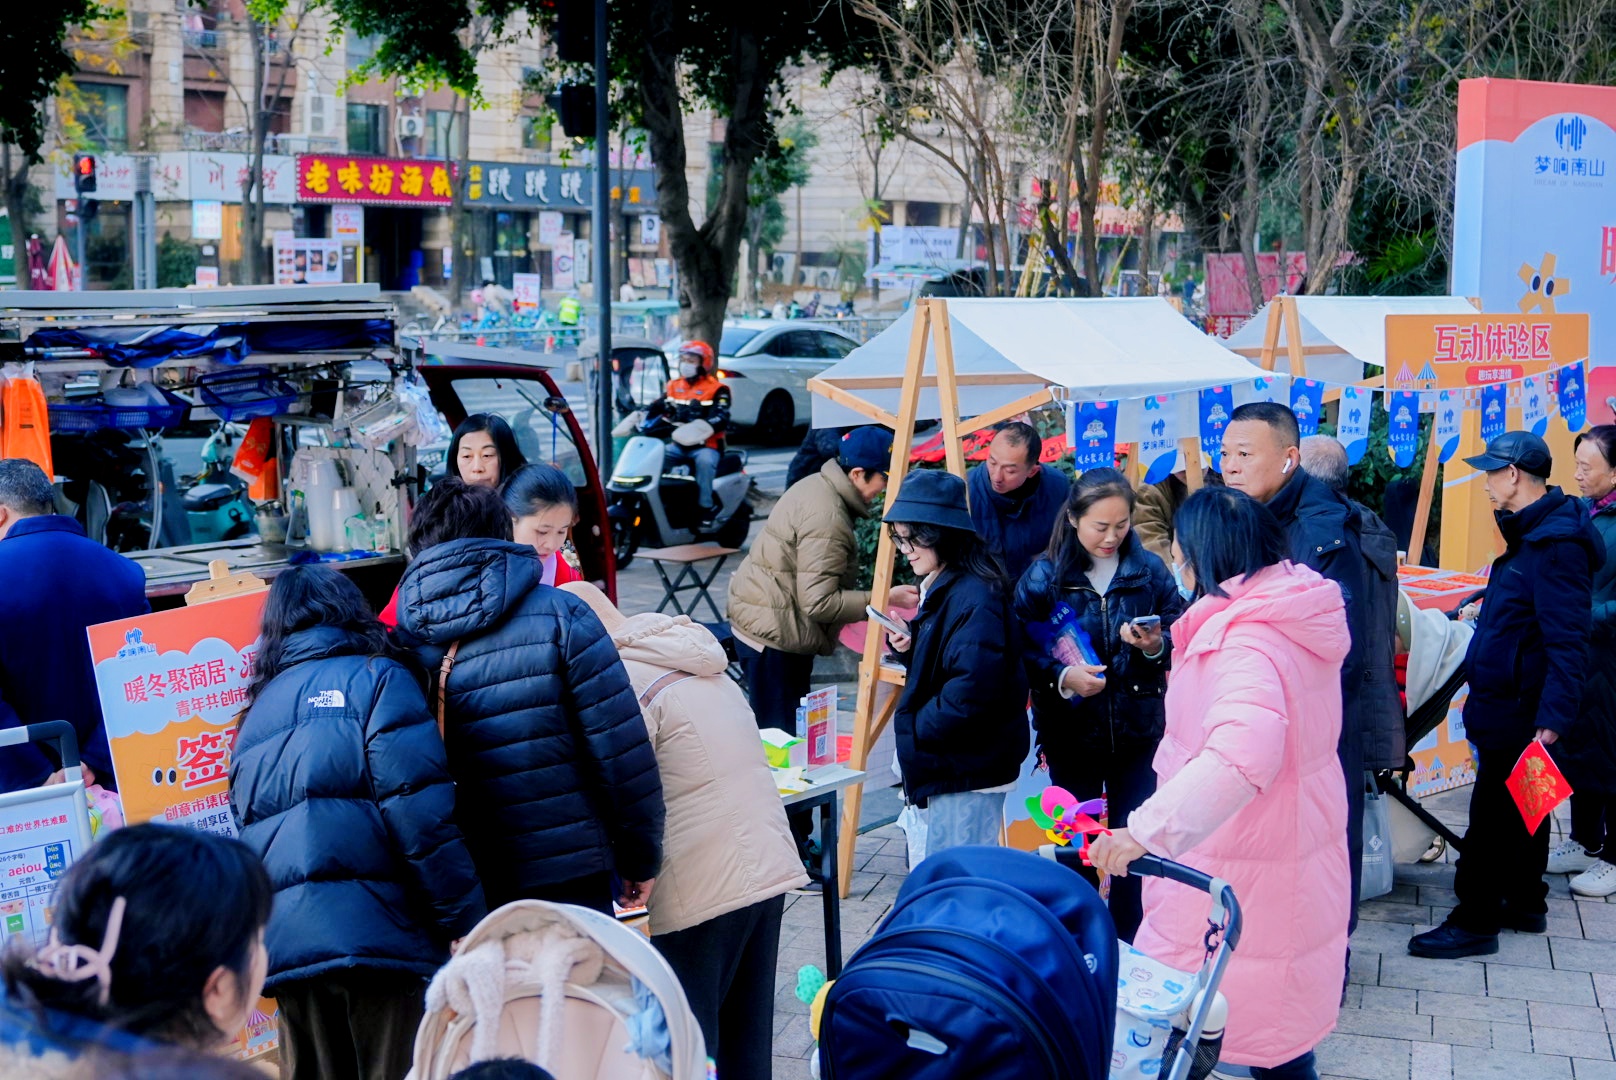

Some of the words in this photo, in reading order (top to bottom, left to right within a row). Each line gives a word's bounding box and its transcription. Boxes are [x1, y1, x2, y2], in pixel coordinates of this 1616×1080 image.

[1534, 155, 1605, 177] 梦响南山
[1433, 322, 1552, 363] 互动体验区
[307, 696, 333, 704] NORTH
[319, 690, 334, 698] THE
[165, 791, 231, 821] 创意市集区
[0, 814, 68, 835] 口难的世界性难题
[8, 863, 42, 877] aeiou
